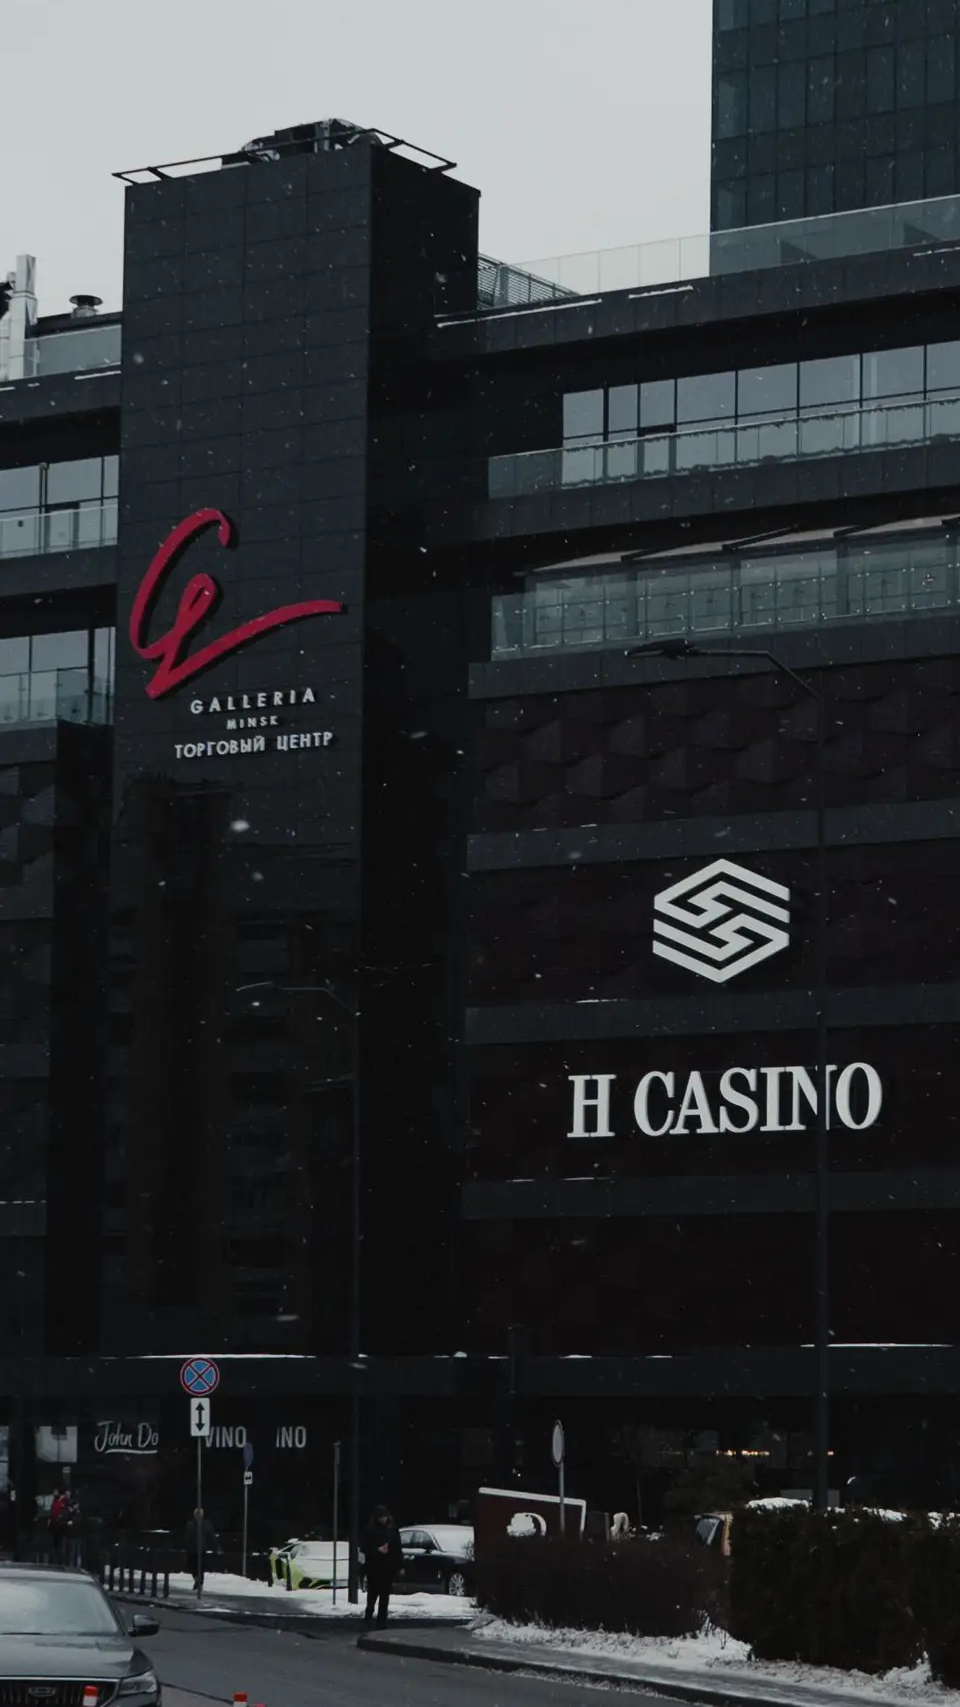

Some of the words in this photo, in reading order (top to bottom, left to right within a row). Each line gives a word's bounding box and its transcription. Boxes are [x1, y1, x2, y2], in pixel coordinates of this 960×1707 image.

[190, 687, 316, 714] GALLERIA
[226, 715, 279, 730] MINSK
[174, 734, 265, 759] ТОРГОВЫЙ
[277, 731, 334, 751] ЦЕНТР
[567, 1074, 617, 1138] H
[633, 1062, 883, 1137] CASINO
[94, 1420, 133, 1453] John
[204, 1425, 247, 1449] VINO
